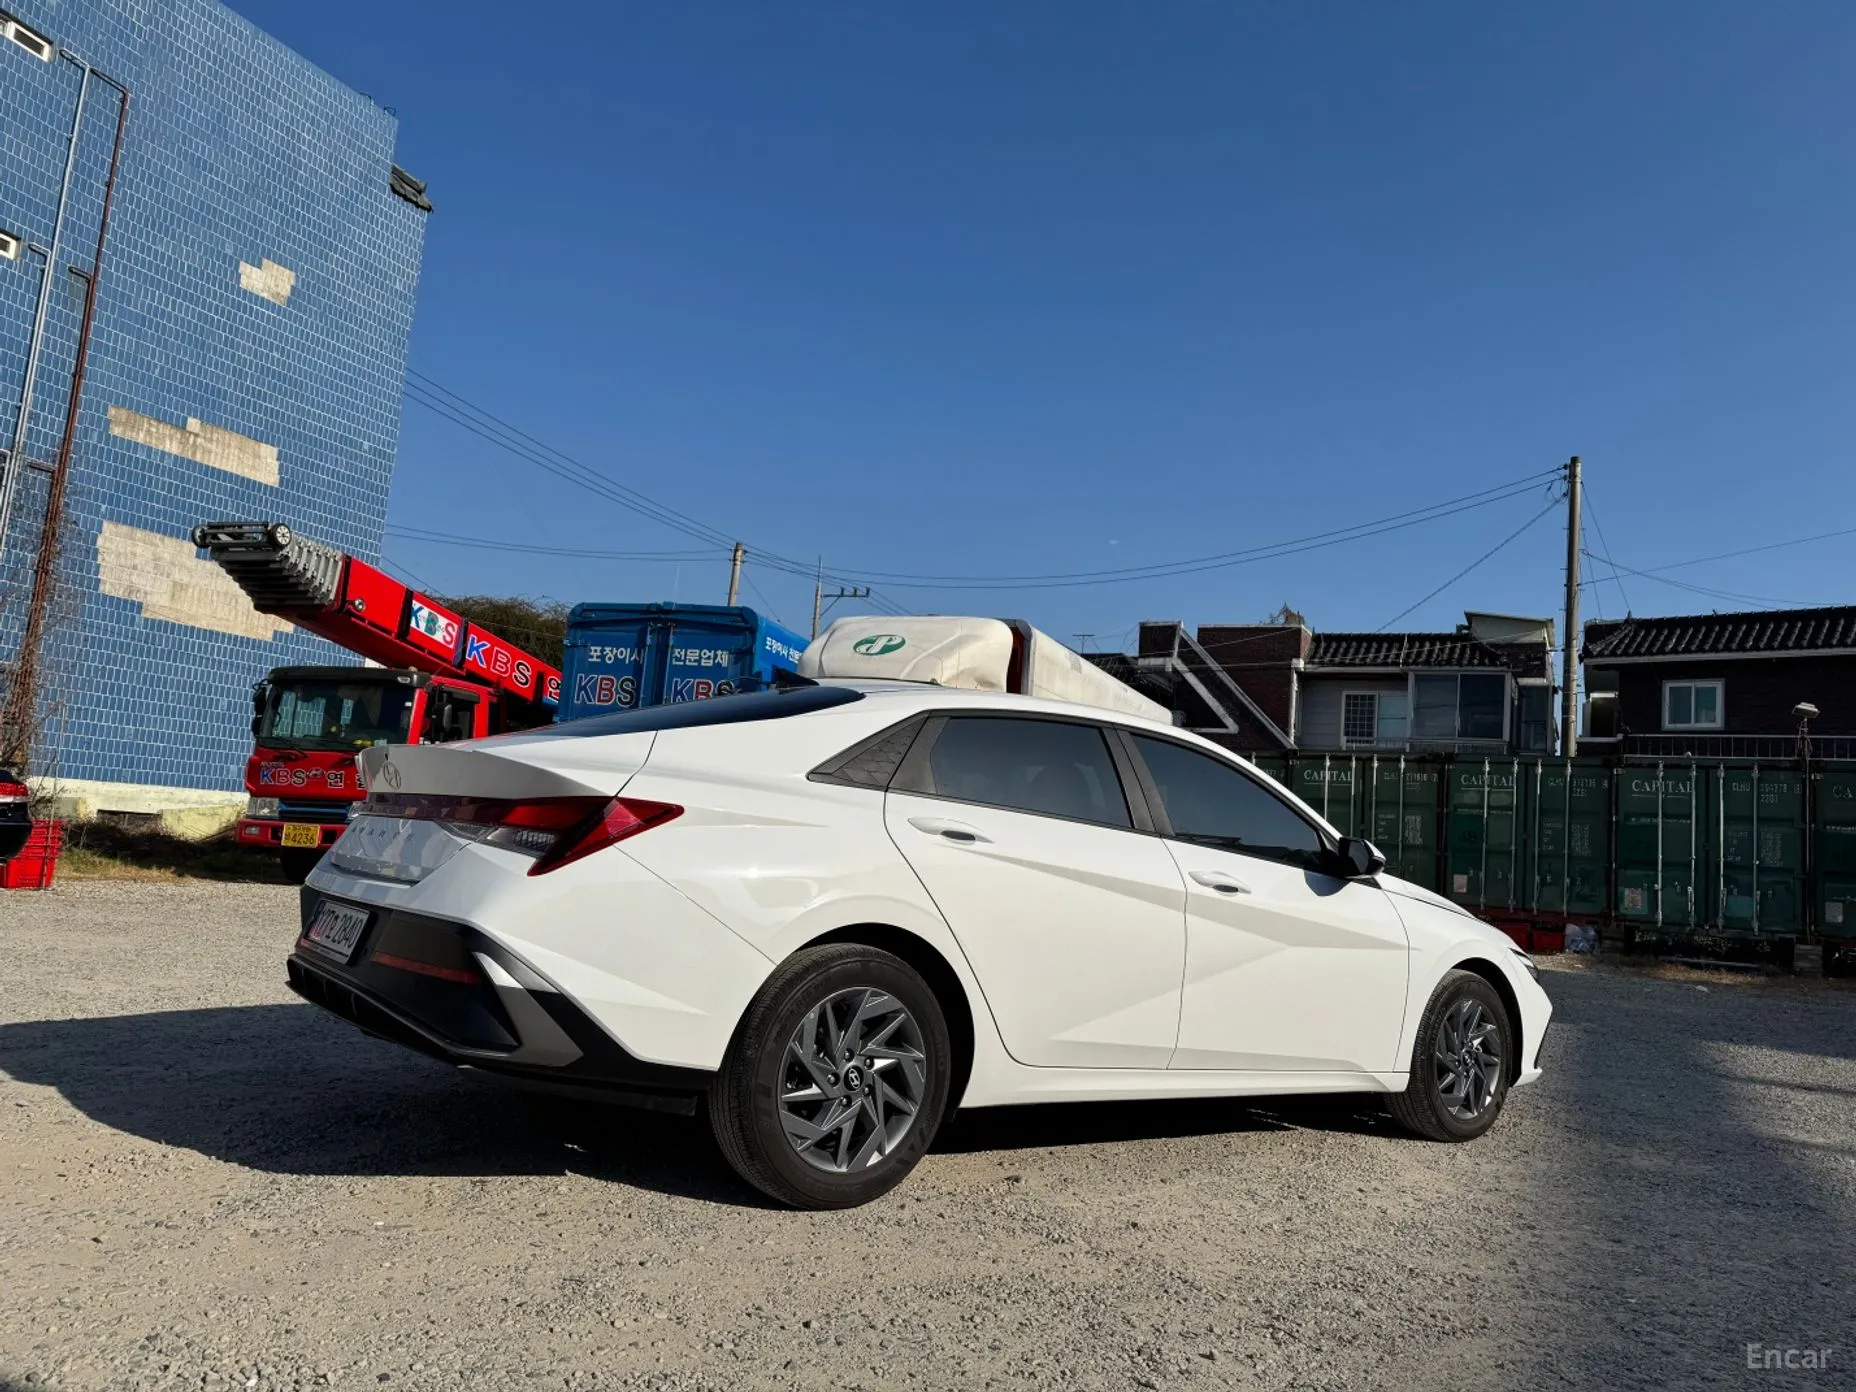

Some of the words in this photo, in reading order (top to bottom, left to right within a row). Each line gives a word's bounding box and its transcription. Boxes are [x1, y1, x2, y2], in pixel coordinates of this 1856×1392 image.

[411, 602, 456, 646] KBS
[465, 634, 532, 688] KBS
[672, 648, 729, 668] 전문업체
[574, 673, 637, 708] KBS
[260, 767, 307, 788] KBS
[1631, 778, 1694, 794] CAPITAL
[291, 832, 315, 845] 4236
